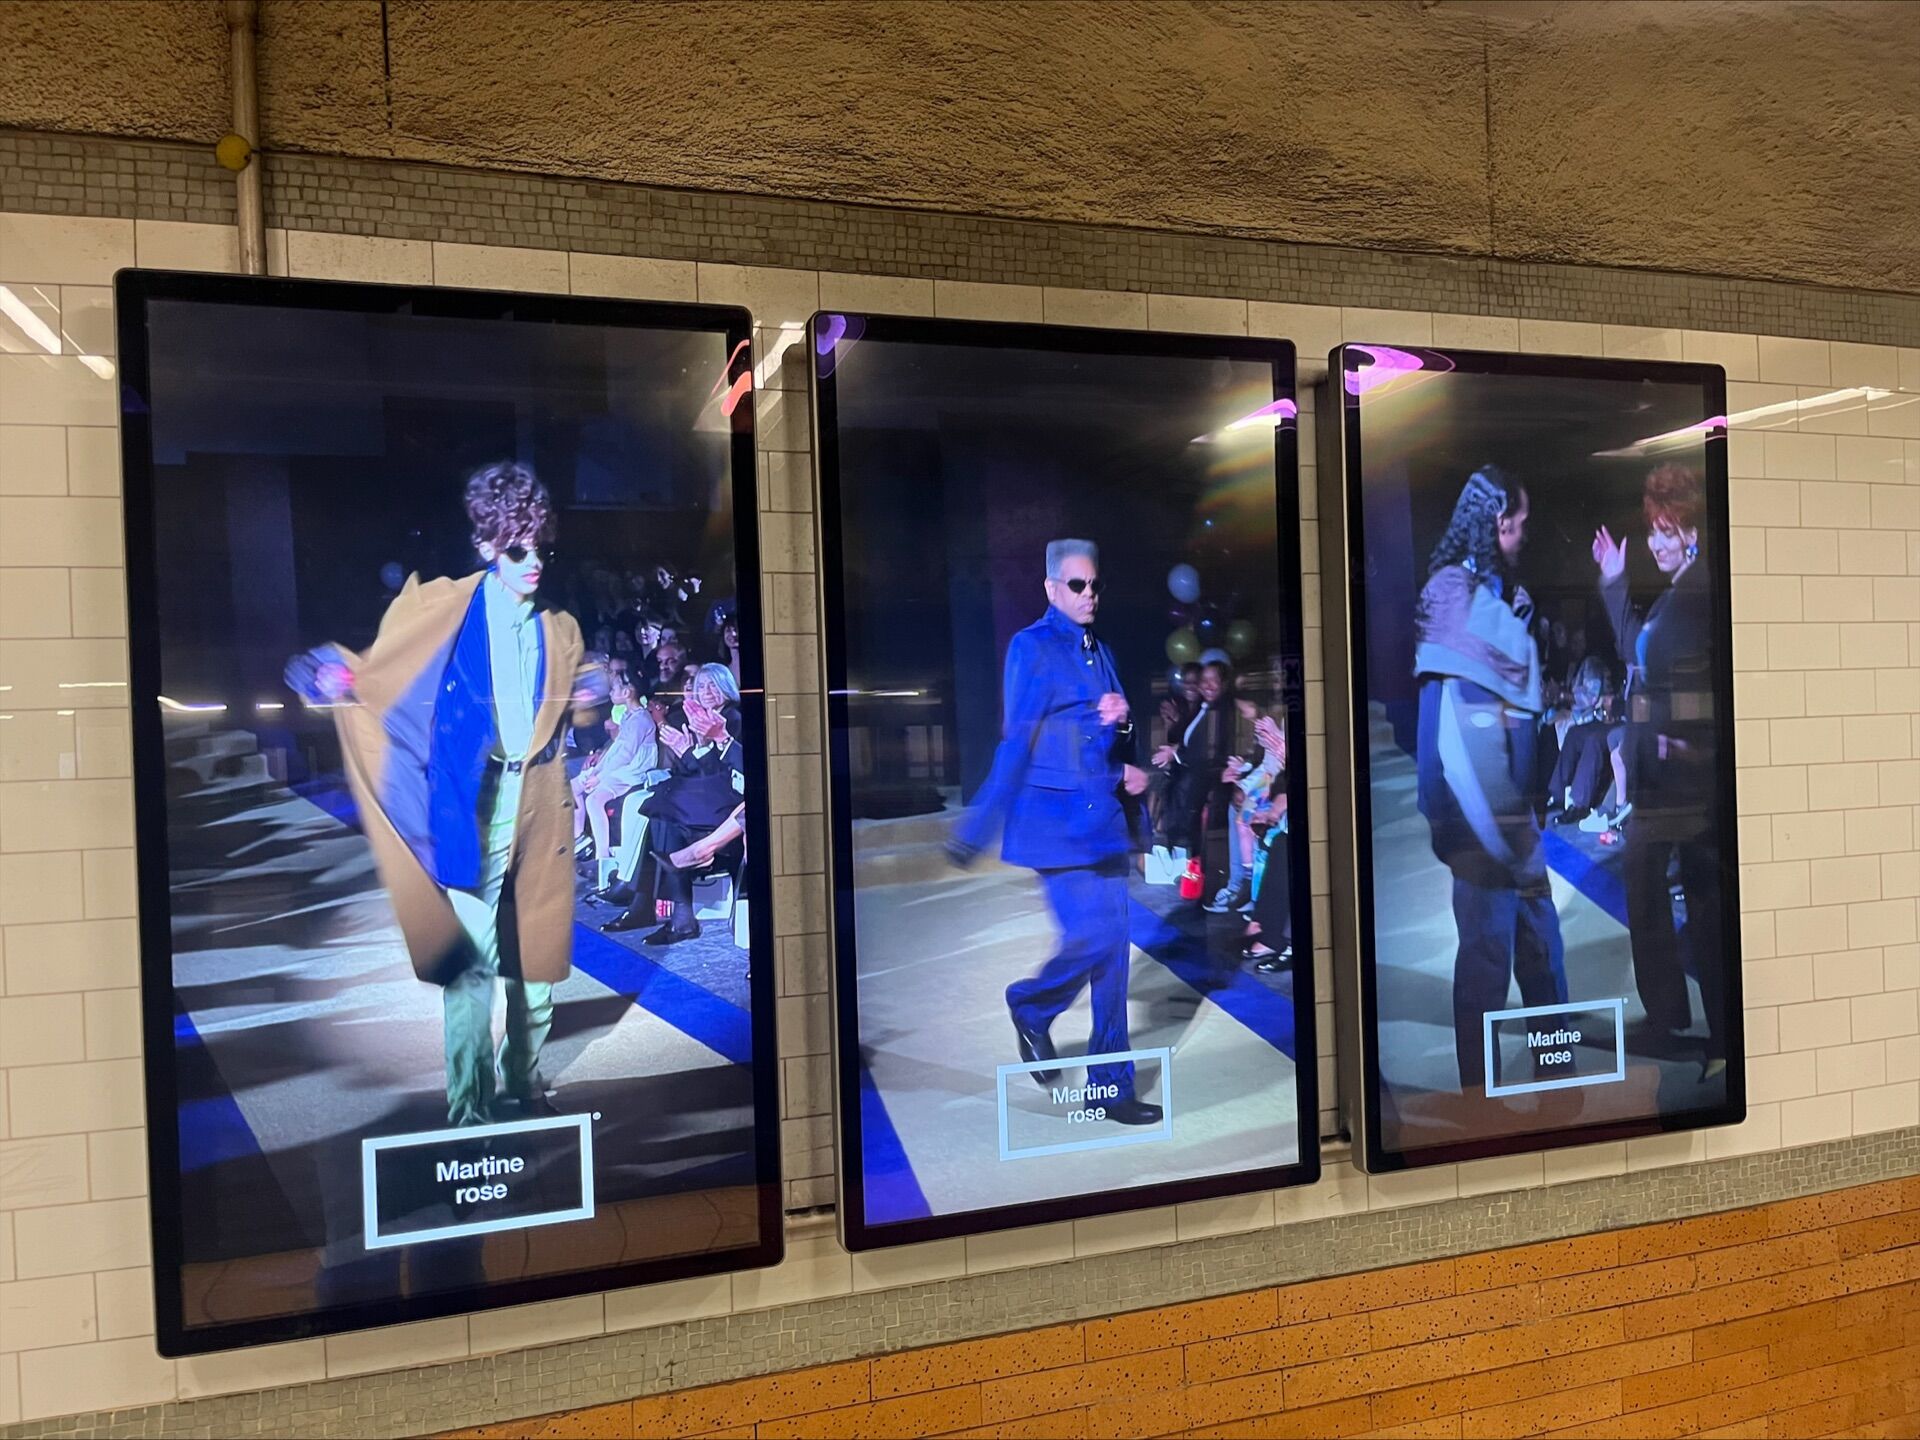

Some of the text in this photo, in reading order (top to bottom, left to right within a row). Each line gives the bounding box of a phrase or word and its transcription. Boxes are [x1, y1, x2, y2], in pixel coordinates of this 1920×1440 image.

[1527, 1029, 1582, 1048] Martine
[1539, 1050, 1571, 1065] rose
[1052, 1083, 1118, 1104] Martine
[1067, 1107, 1106, 1124] rose
[436, 1155, 524, 1182] Martine
[456, 1183, 508, 1204] rose
